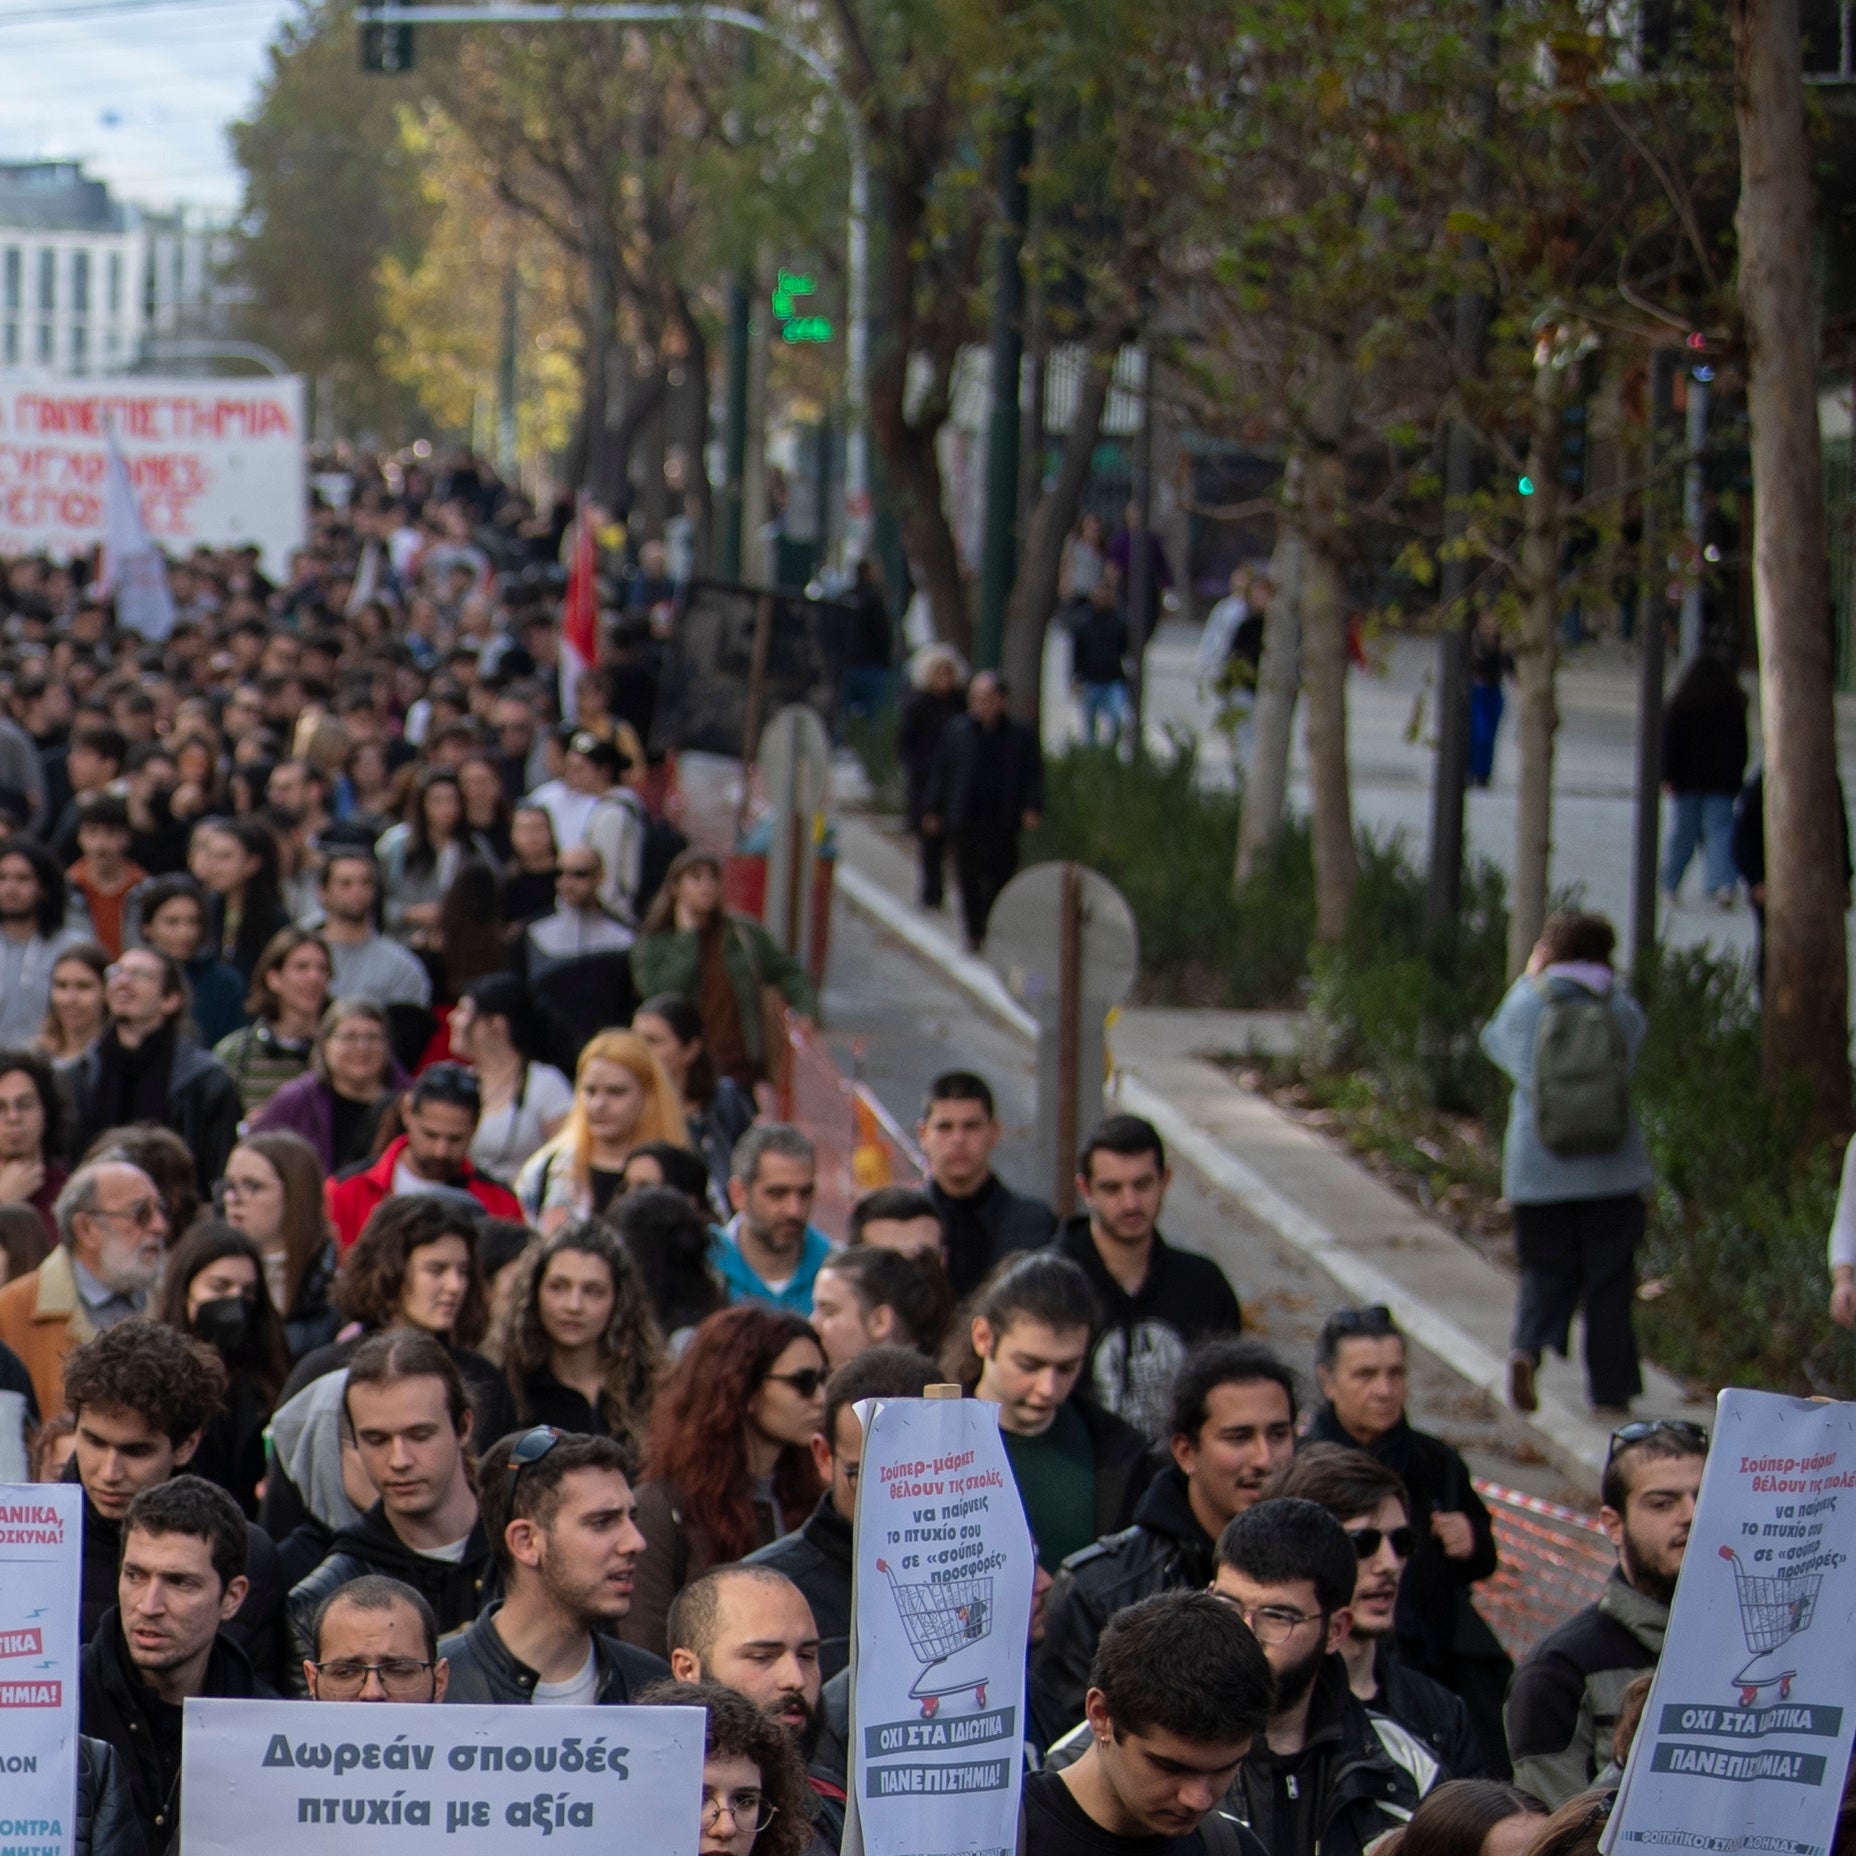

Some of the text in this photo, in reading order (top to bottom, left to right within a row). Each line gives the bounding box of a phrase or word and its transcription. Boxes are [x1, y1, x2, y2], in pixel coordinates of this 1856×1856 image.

[880, 1450, 974, 1482] Σούπερ-μάρκετ
[890, 1467, 1004, 1500] θέλουν τις σχολές,
[1752, 1474, 1806, 1493] θέλουν
[913, 1496, 988, 1523] να παίρνεις
[1776, 1505, 1794, 1519] να
[887, 1523, 981, 1544] το πτυχίο σου
[1742, 1522, 1758, 1535] το
[1762, 1520, 1806, 1538] πτυχίο
[902, 1541, 984, 1569] σε «σούπερ
[930, 1549, 1007, 1585] προσφορές»
[1754, 1549, 1773, 1562] σε
[880, 1715, 1003, 1749] ΟΧΙ ΣΤΑ ΙΔΙΩΤΙΚΑ
[1681, 1709, 1715, 1729] ΟΧΙ
[1718, 1712, 1757, 1733] ΣΤΑ
[261, 1733, 631, 1781] Δωρεάν σπουδές
[880, 1763, 1000, 1794] ΠΑΝΕΠΙΣΤΗΜΙΑ!
[297, 1790, 595, 1836] πτυχία με αξία
[1641, 1830, 1710, 1850] ΦΟΙΤΗΤΙΚΟΙ
